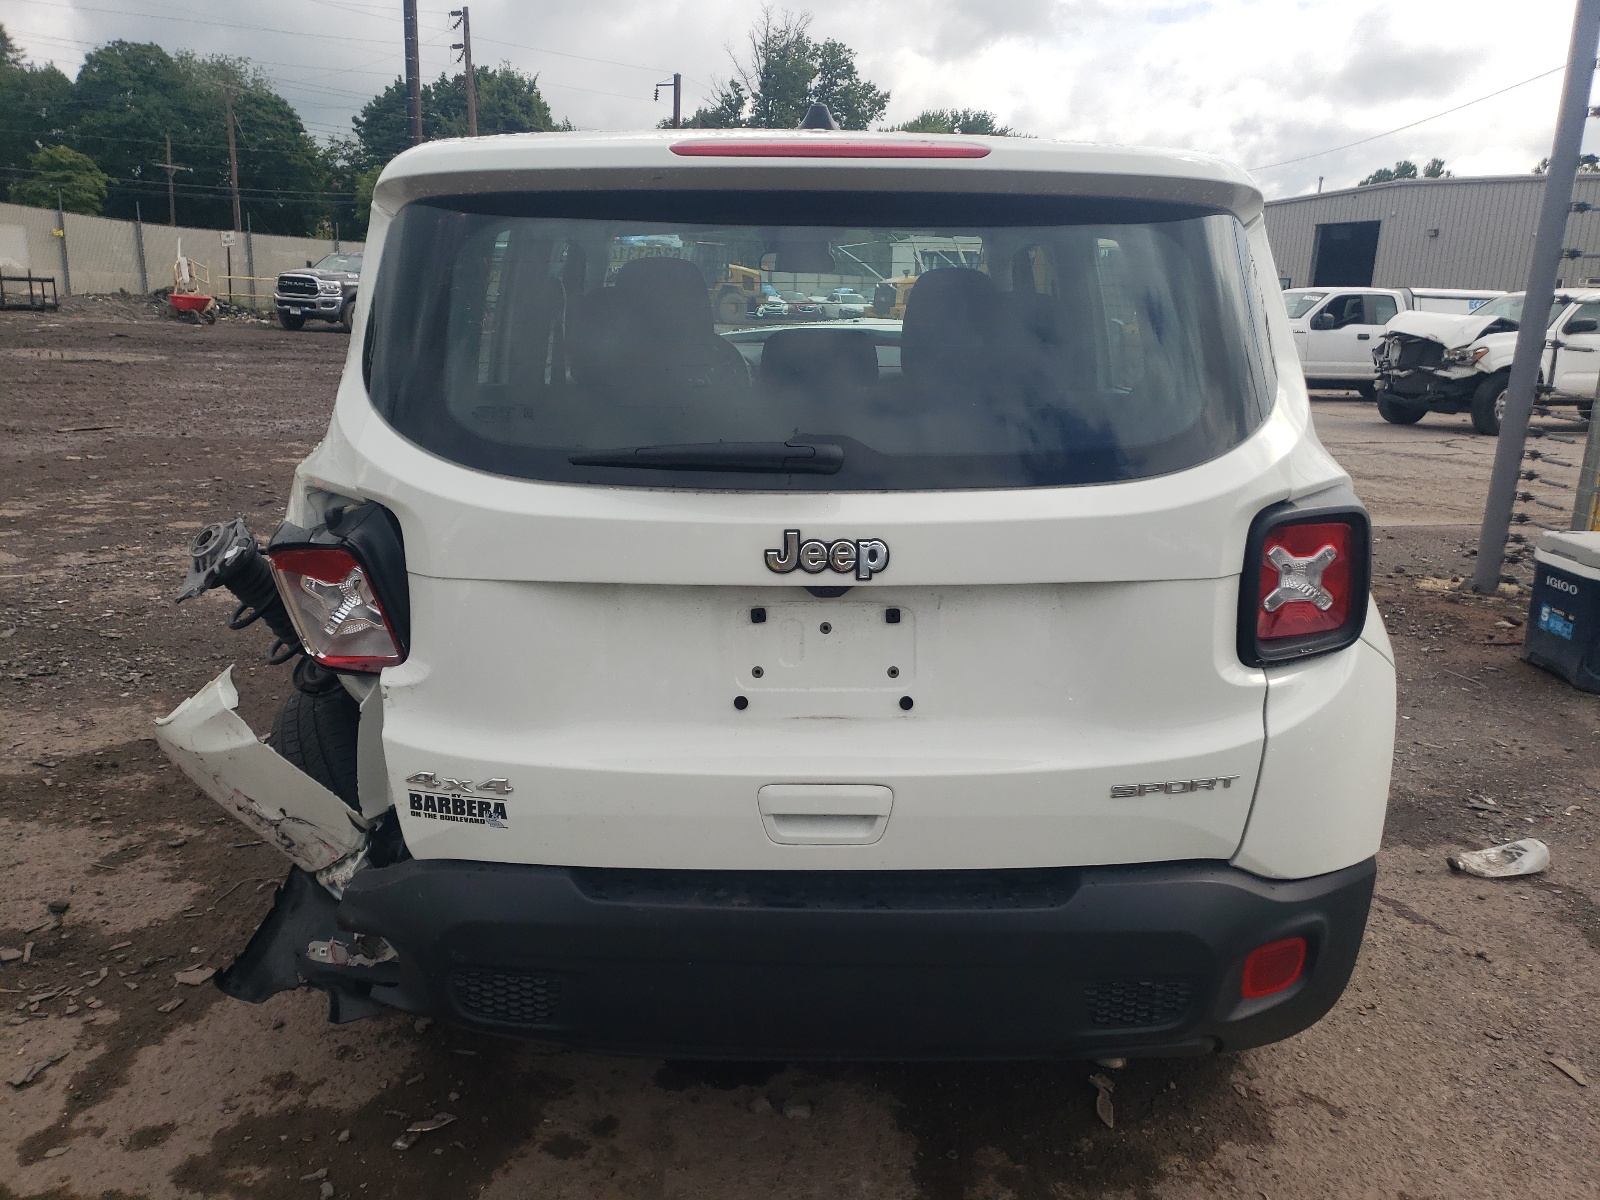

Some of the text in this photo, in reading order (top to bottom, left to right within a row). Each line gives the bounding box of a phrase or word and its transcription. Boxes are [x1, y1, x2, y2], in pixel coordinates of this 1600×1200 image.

[764, 529, 890, 581] Jeep
[1546, 575, 1578, 595] IGLOO
[1109, 773, 1241, 799] SPORT
[409, 793, 508, 820] BARBERA
[424, 812, 437, 820] THE
[440, 815, 486, 825] BOULEVARD
